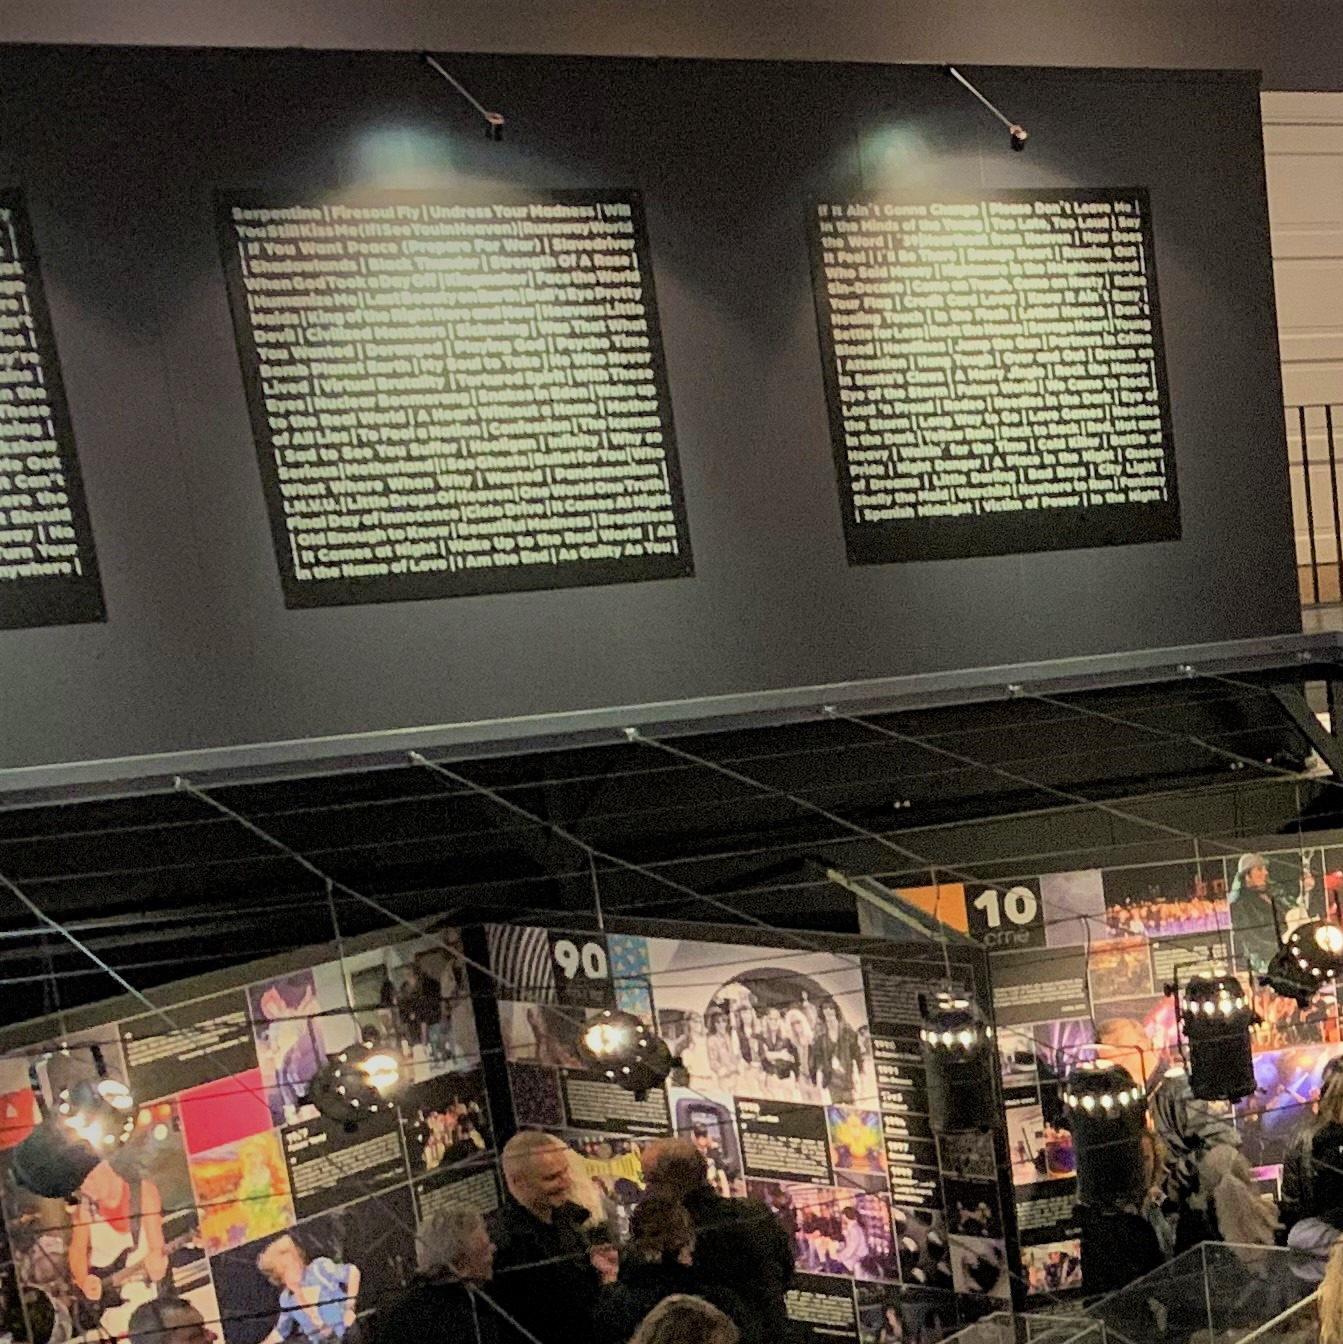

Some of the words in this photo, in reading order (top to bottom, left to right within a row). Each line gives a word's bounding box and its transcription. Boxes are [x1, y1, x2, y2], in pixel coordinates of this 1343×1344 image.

[0, 546, 34, 560] urn
[974, 886, 1037, 928] 10
[554, 939, 608, 979] 90
